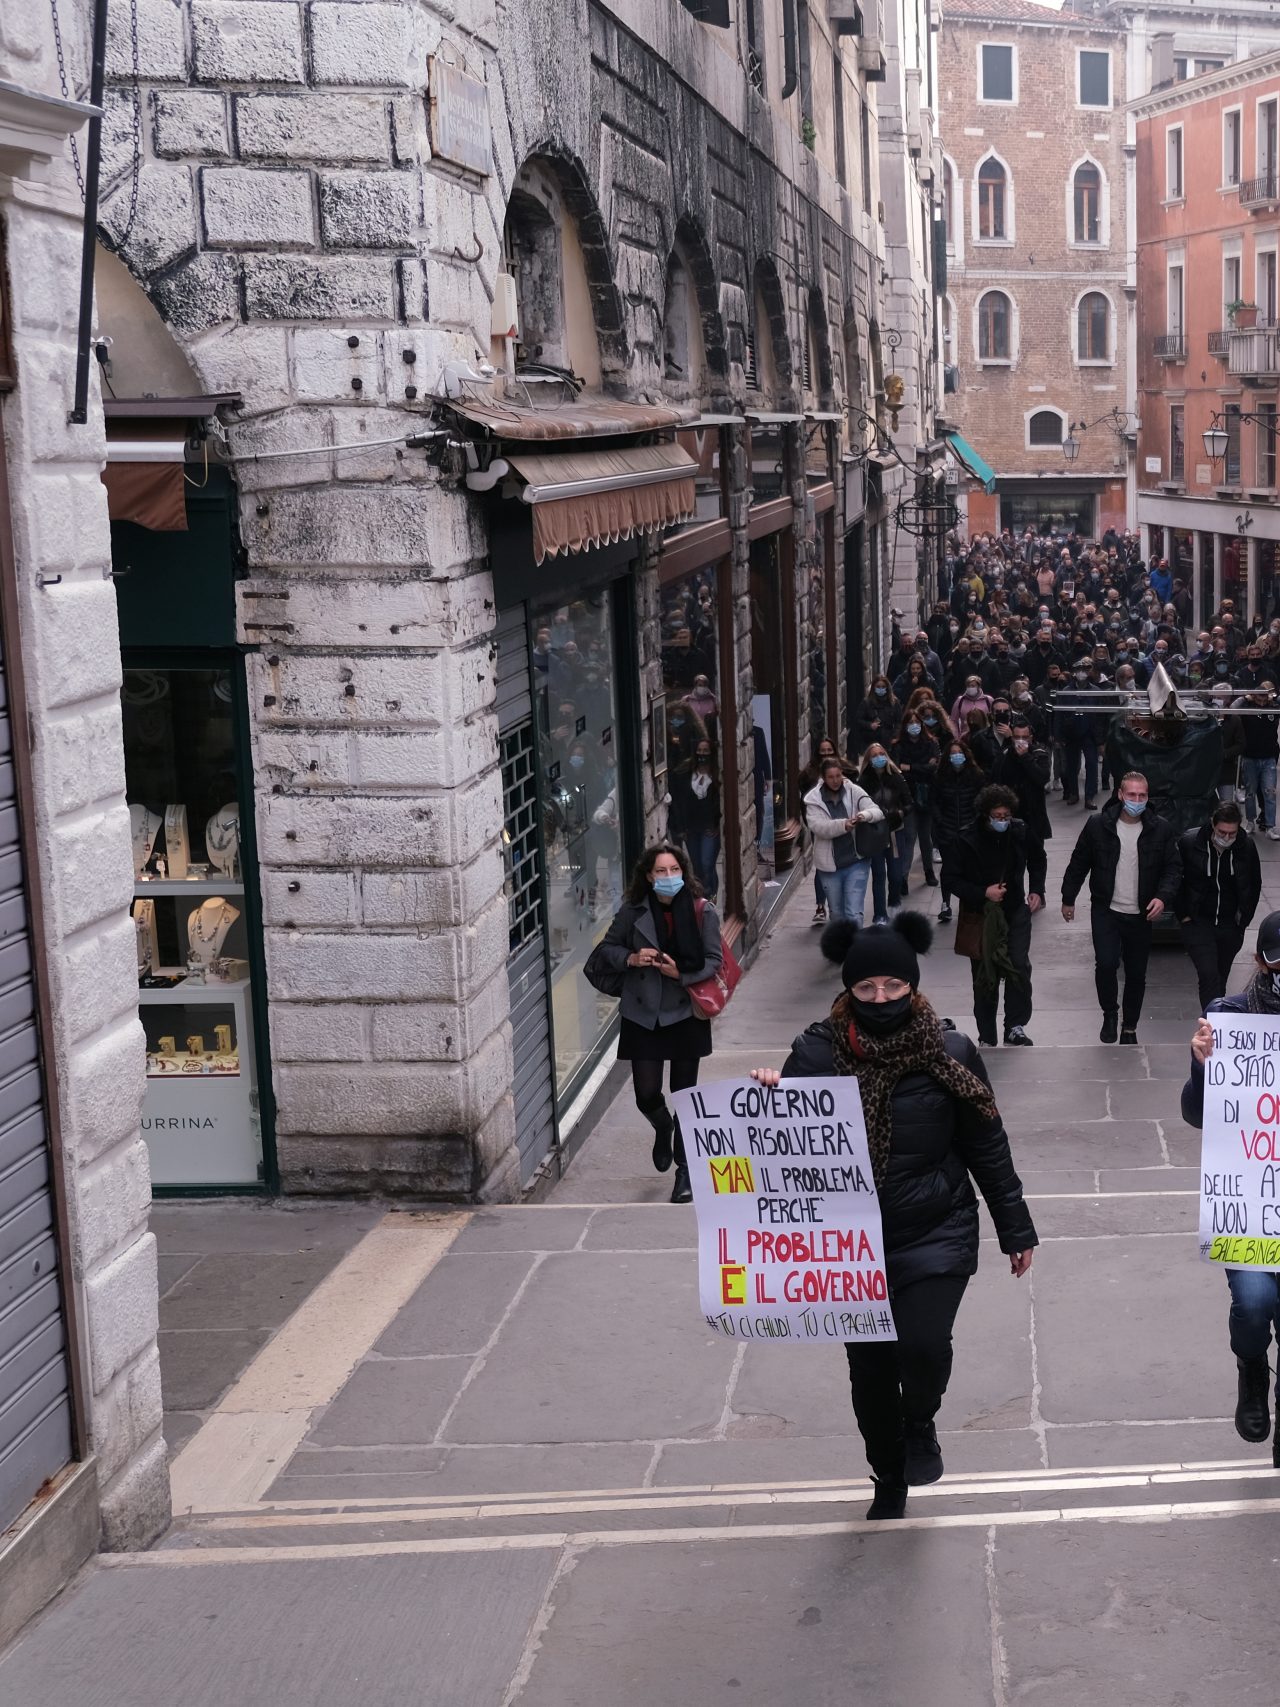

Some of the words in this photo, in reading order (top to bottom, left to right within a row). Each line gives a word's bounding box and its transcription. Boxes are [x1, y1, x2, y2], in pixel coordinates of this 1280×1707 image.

[1228, 1030, 1256, 1050] SENSI
[1208, 1060, 1226, 1086] LO
[1231, 1054, 1275, 1088] STATO
[690, 1092, 720, 1119] IL
[730, 1087, 835, 1119] GOVERNO
[1224, 1099, 1239, 1124] DI
[694, 1127, 736, 1157] NON
[760, 1167, 779, 1193] IL
[781, 1164, 875, 1196] PROBLEMA,
[1204, 1173, 1243, 1197] DELLE
[718, 1228, 736, 1265] IL
[747, 1229, 876, 1264] PROBLEMA
[755, 1273, 776, 1303] IL
[783, 1269, 887, 1303] GOVERNO
[740, 1315, 754, 1338] CI
[798, 1307, 819, 1337] TU
[824, 1311, 838, 1337] CI
